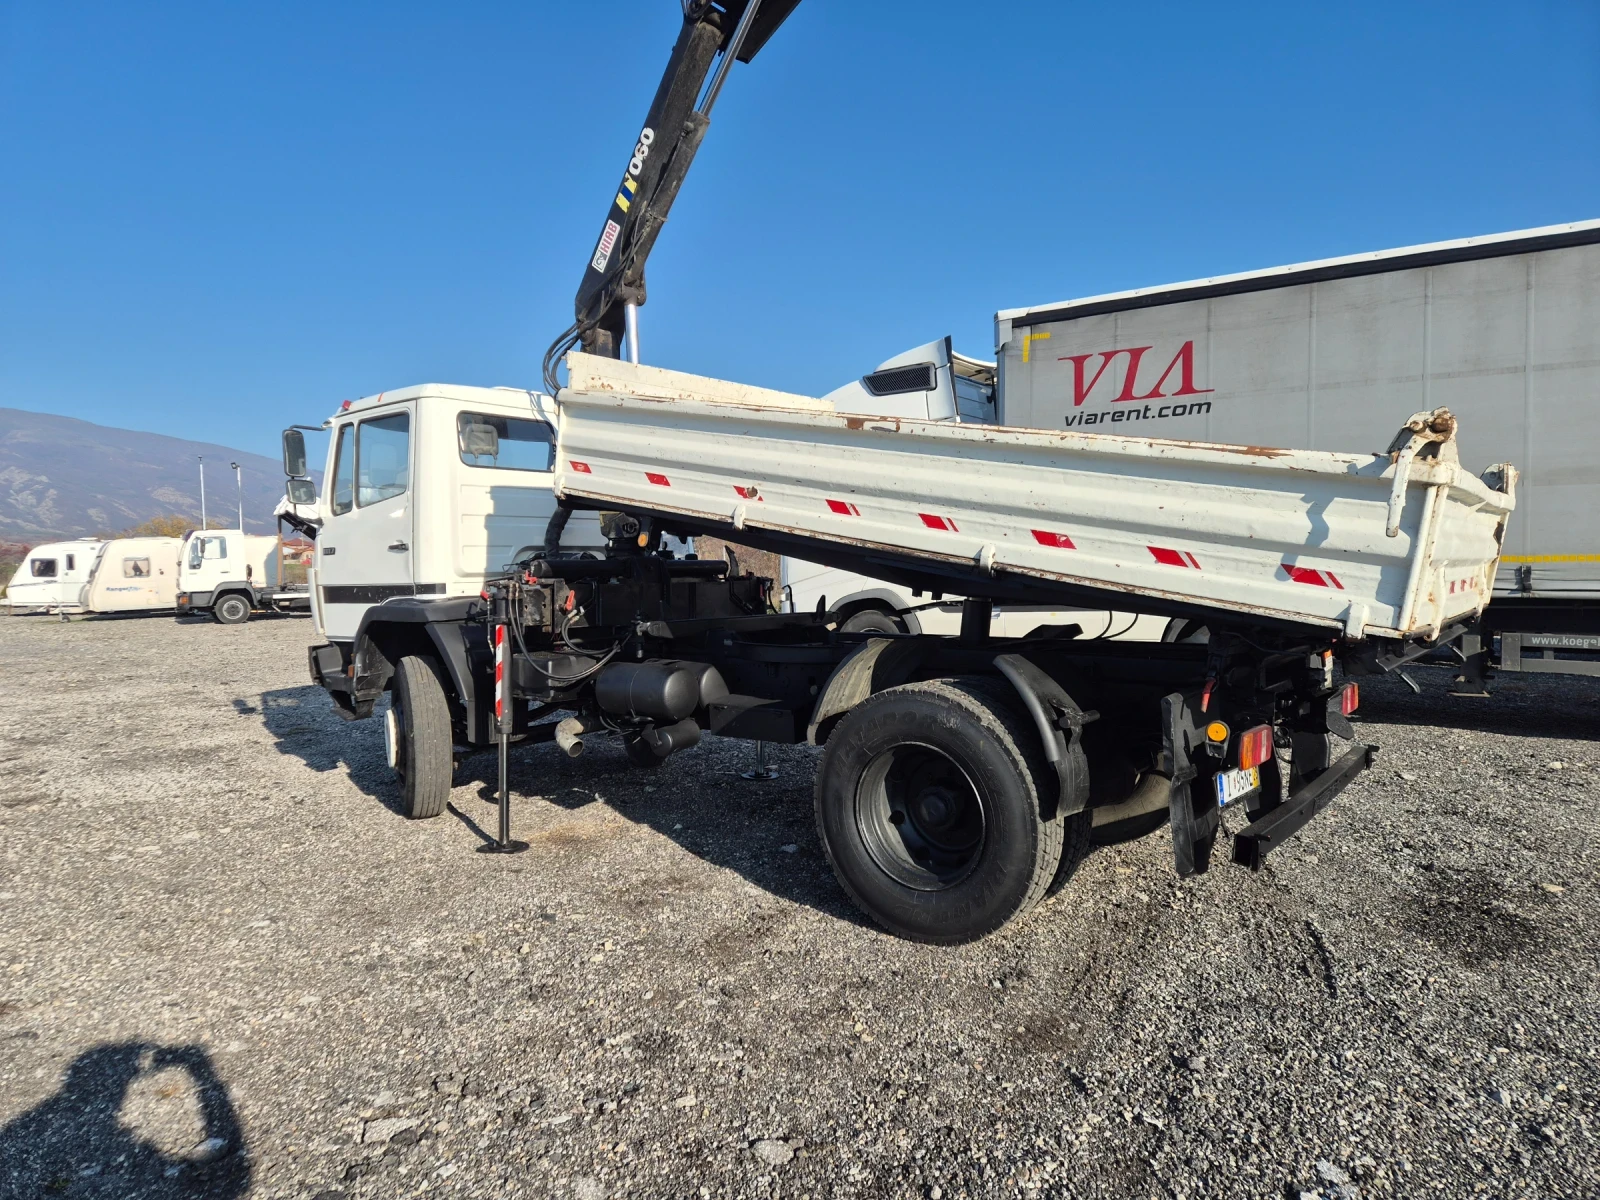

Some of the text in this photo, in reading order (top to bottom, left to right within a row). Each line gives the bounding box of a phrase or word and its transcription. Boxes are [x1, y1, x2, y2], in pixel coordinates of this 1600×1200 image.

[628, 127, 655, 176] 060
[599, 222, 618, 253] HIAB
[1057, 340, 1215, 406] VIA
[1064, 401, 1212, 427] viarent.com
